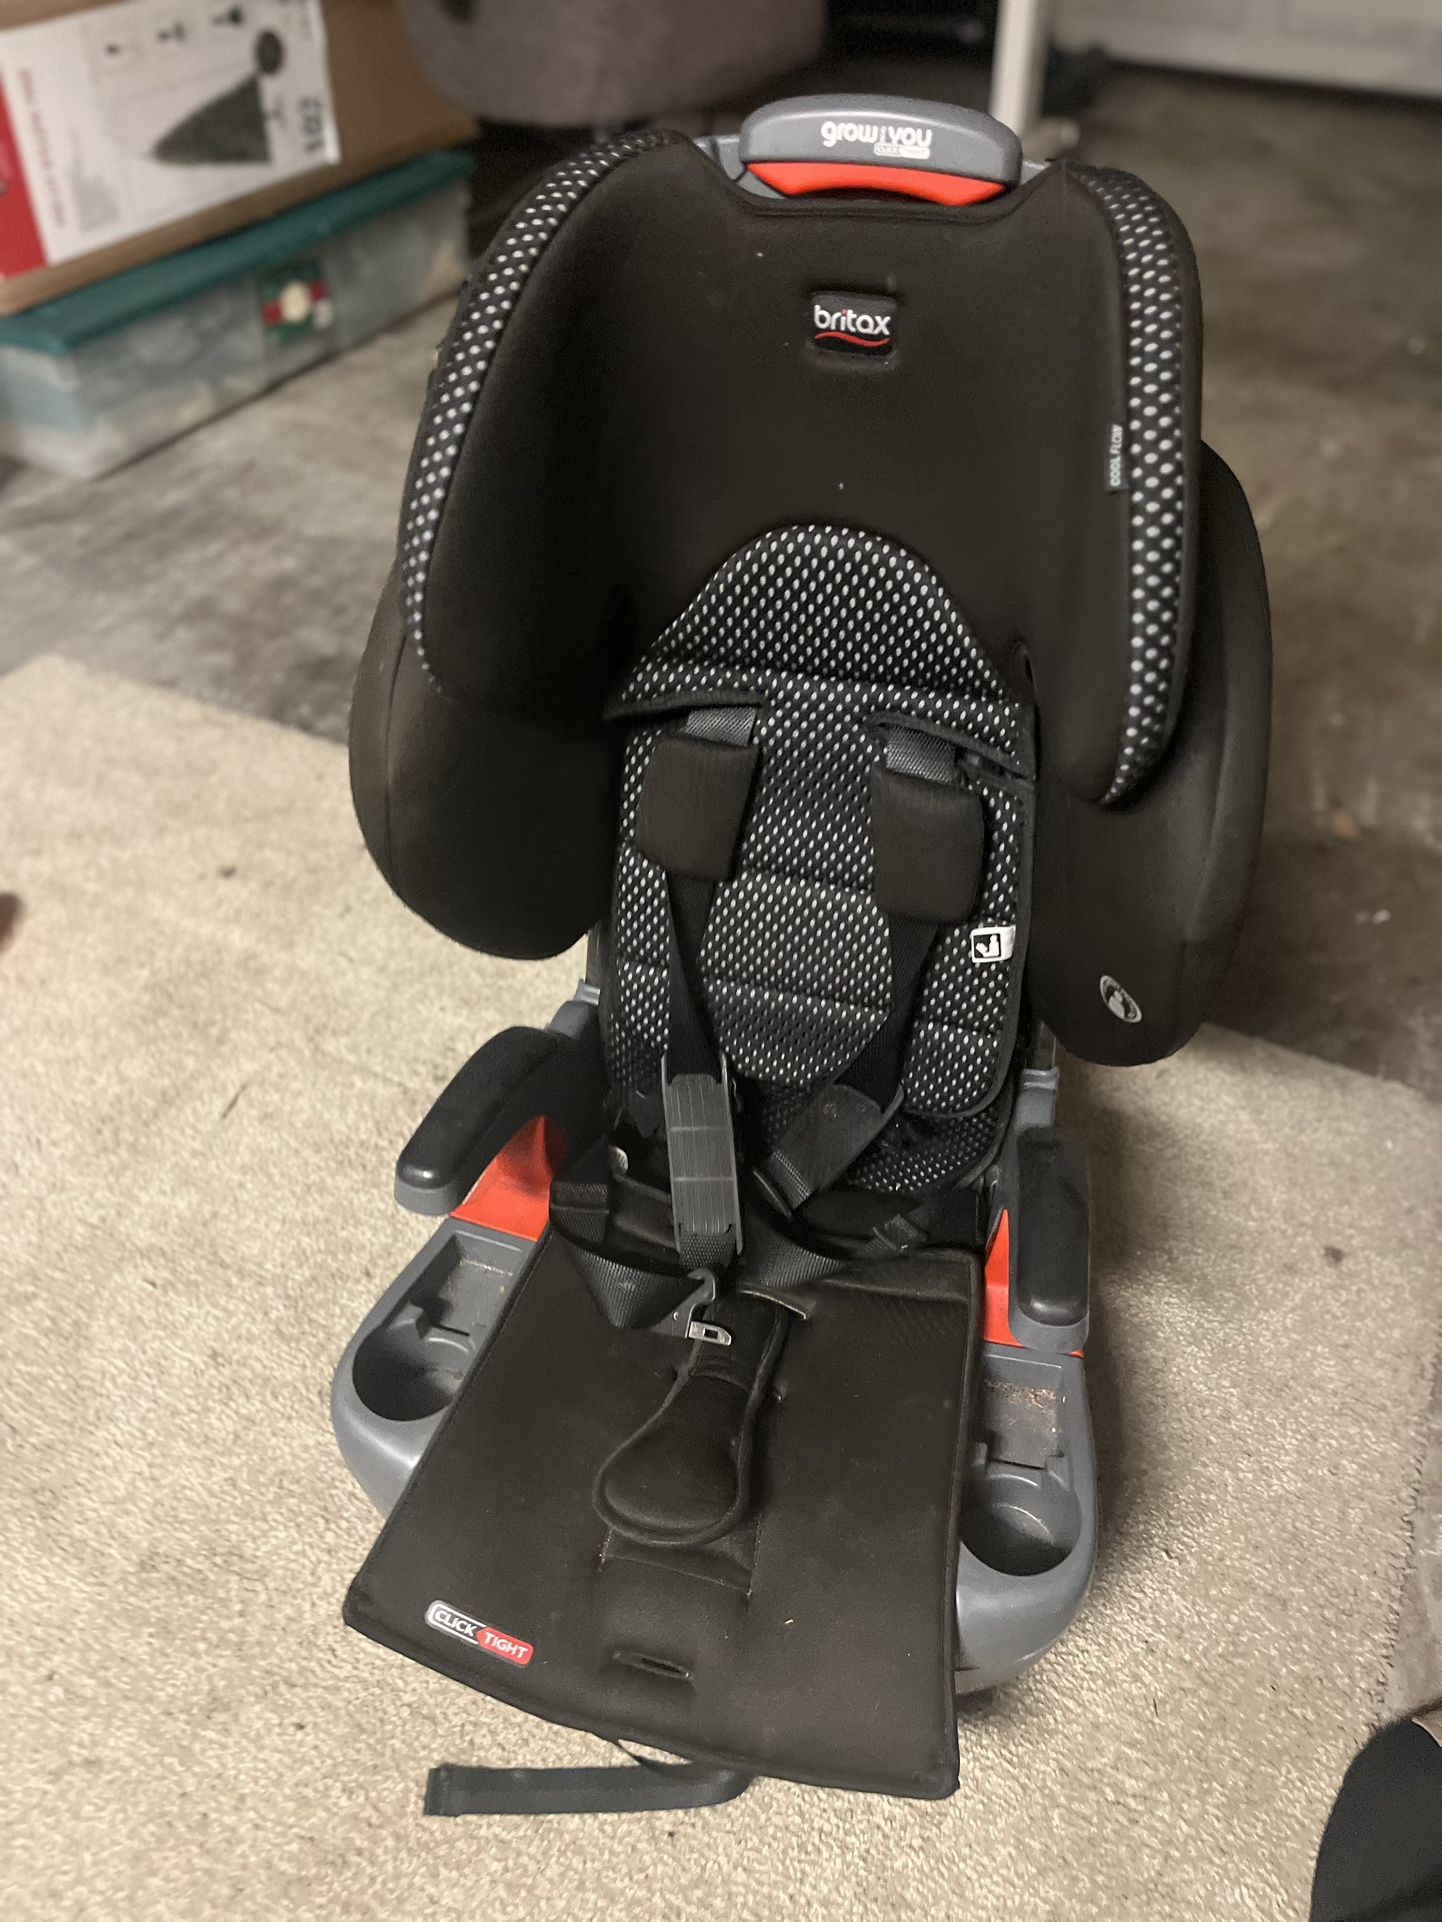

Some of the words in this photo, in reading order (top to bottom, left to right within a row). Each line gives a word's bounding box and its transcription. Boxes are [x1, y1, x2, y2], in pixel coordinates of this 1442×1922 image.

[821, 121, 878, 148] grow
[888, 126, 933, 147] you
[814, 304, 891, 336] britax
[1110, 424, 1123, 454] FLOW
[1109, 455, 1121, 487] COOL
[434, 1609, 478, 1637] CLICK
[484, 1631, 529, 1659] TIGHT
